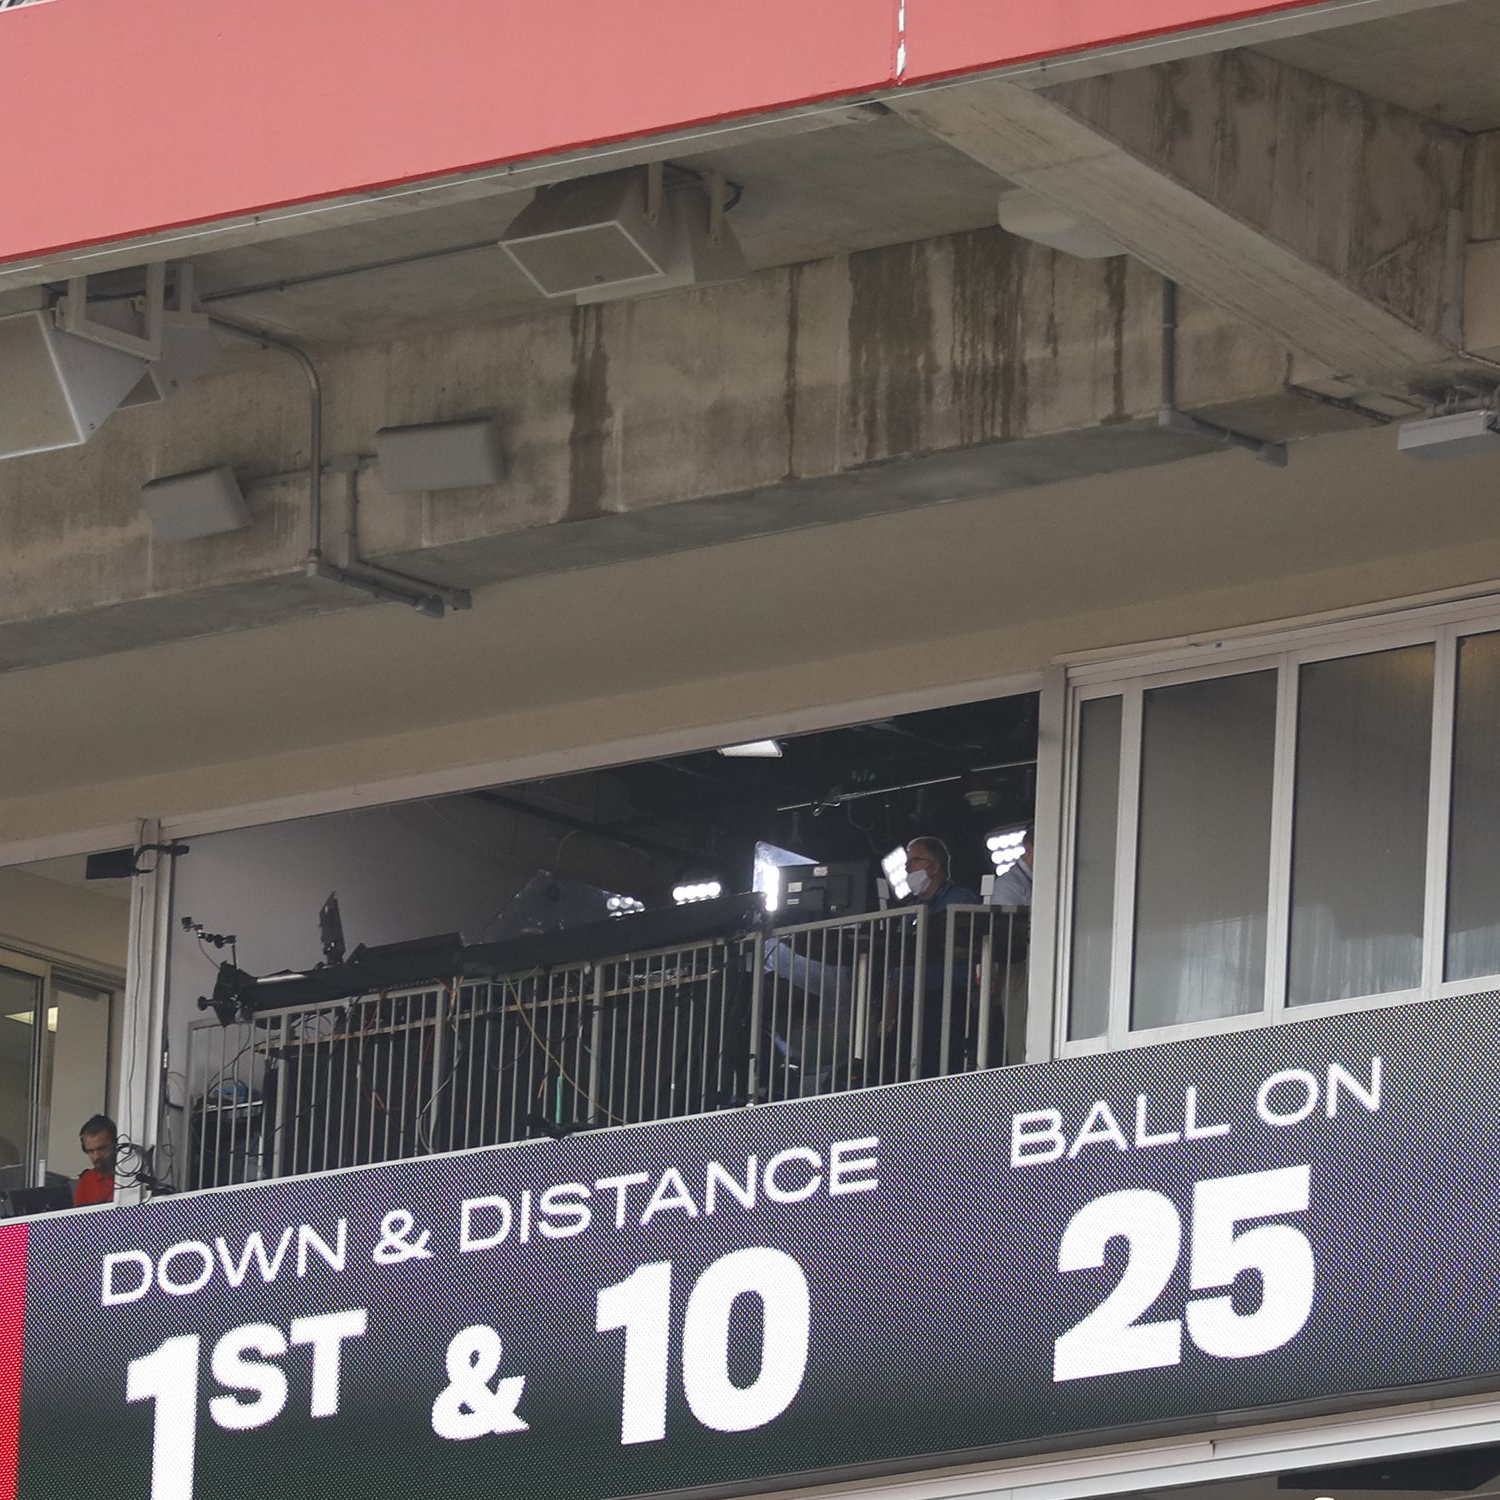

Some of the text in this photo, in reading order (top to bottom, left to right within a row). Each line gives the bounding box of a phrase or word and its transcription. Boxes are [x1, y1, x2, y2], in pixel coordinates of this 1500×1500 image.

[1009, 1057, 1382, 1168] BALL ON
[101, 1136, 881, 1306] DOWN & DISTANCE
[1054, 1164, 1315, 1381] 25
[431, 1325, 529, 1440] &
[595, 1247, 811, 1445] 10
